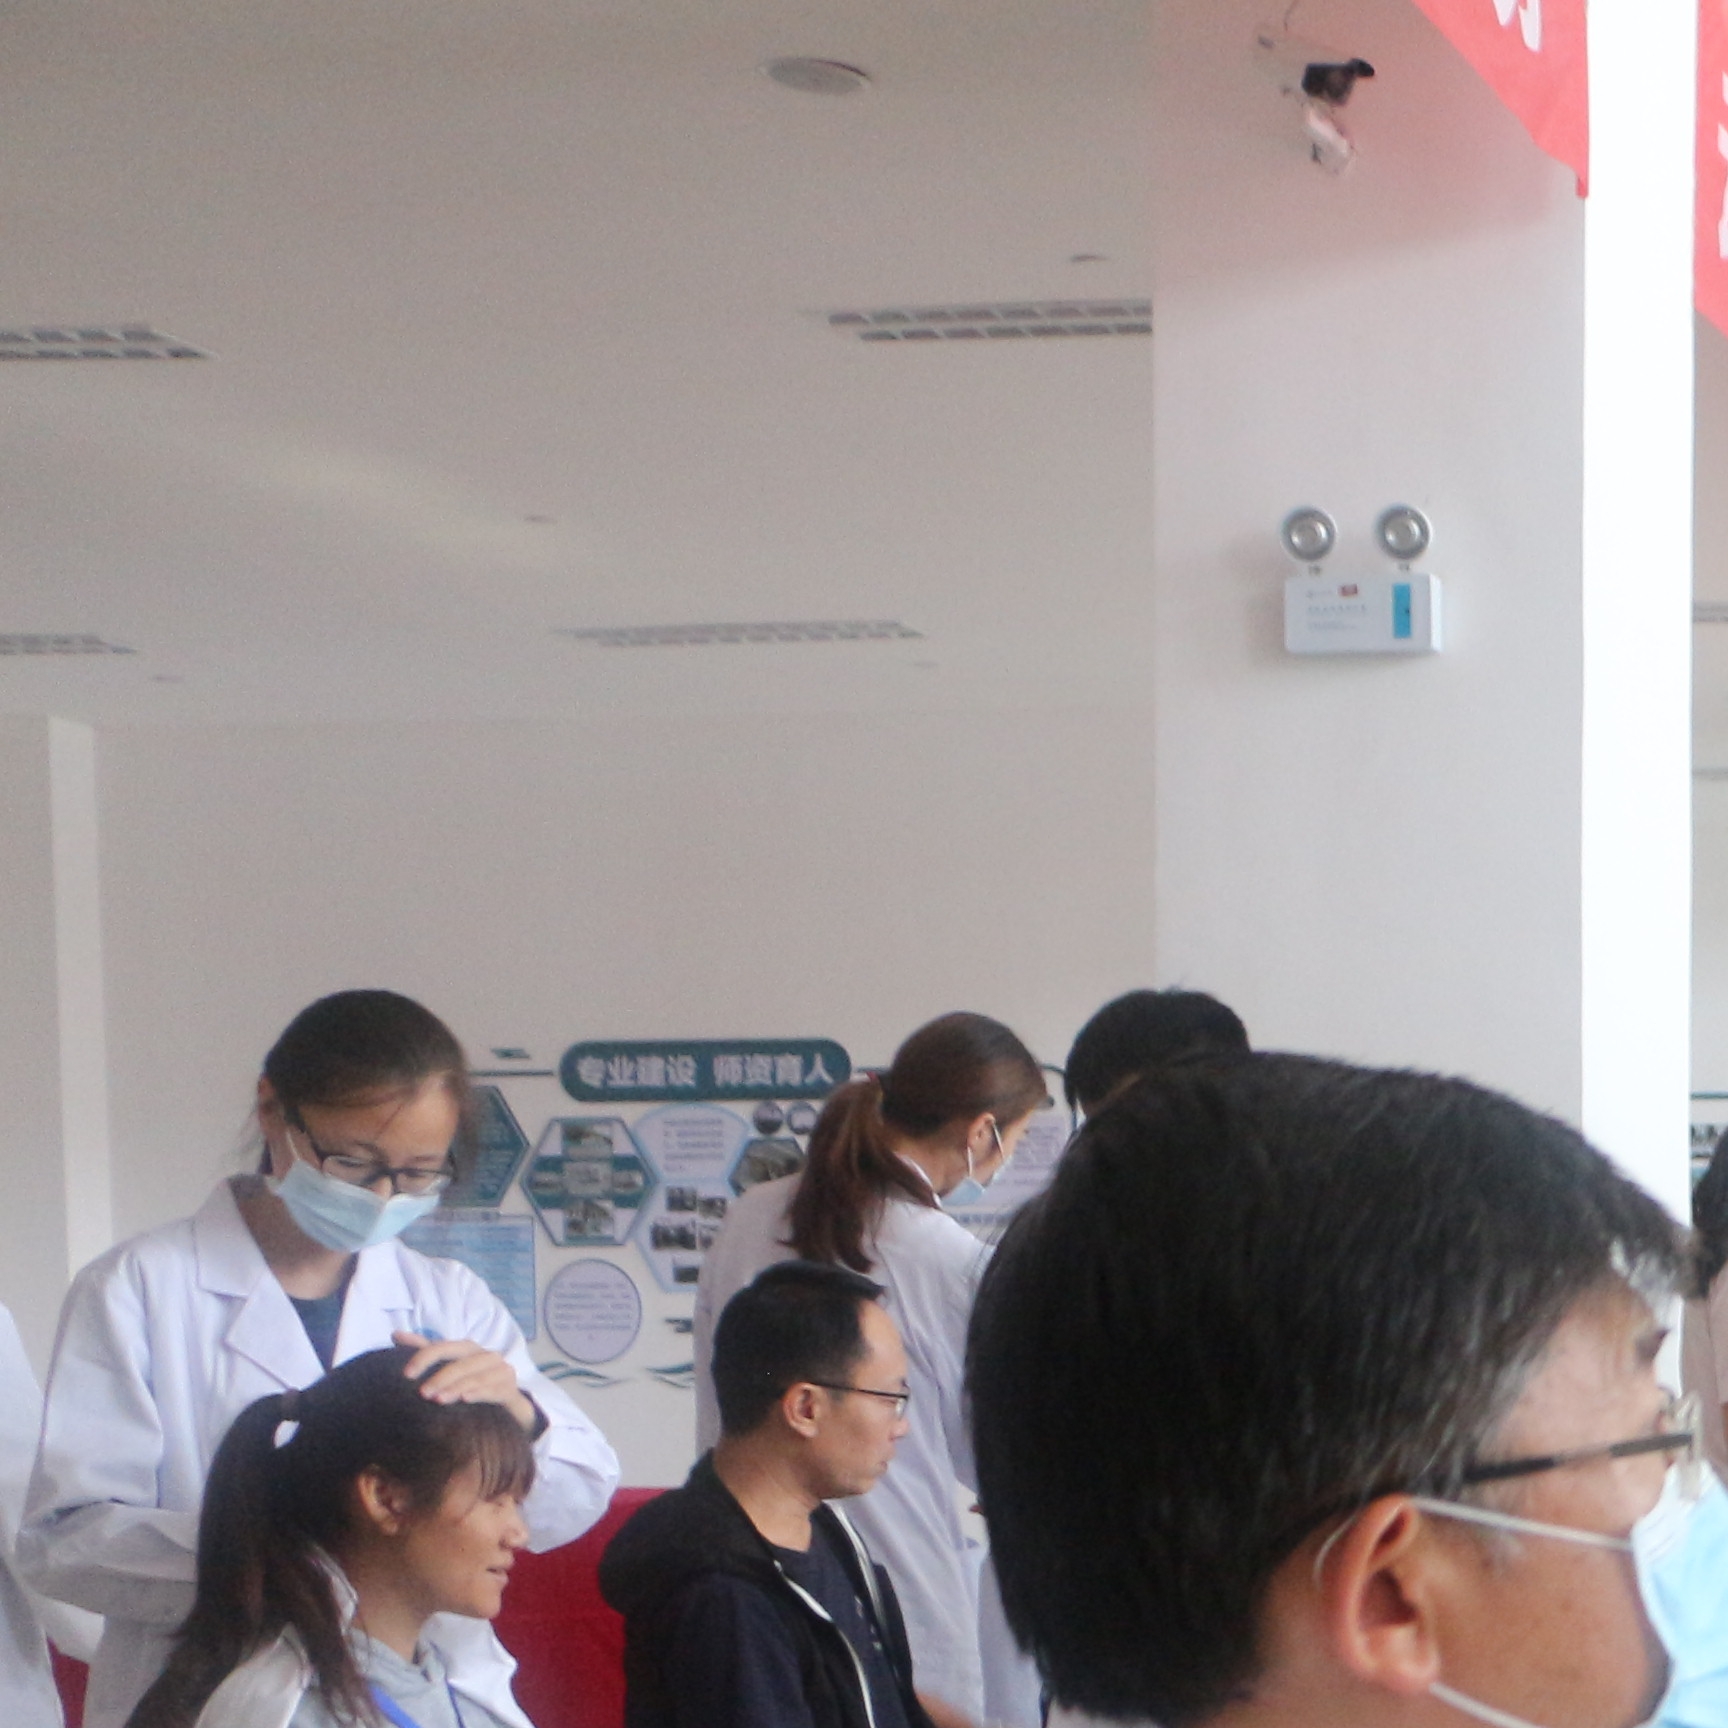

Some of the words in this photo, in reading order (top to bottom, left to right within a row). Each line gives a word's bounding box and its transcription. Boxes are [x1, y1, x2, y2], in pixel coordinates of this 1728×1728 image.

[576, 1054, 697, 1090] 专业建设
[712, 1053, 834, 1087] 师资育人
